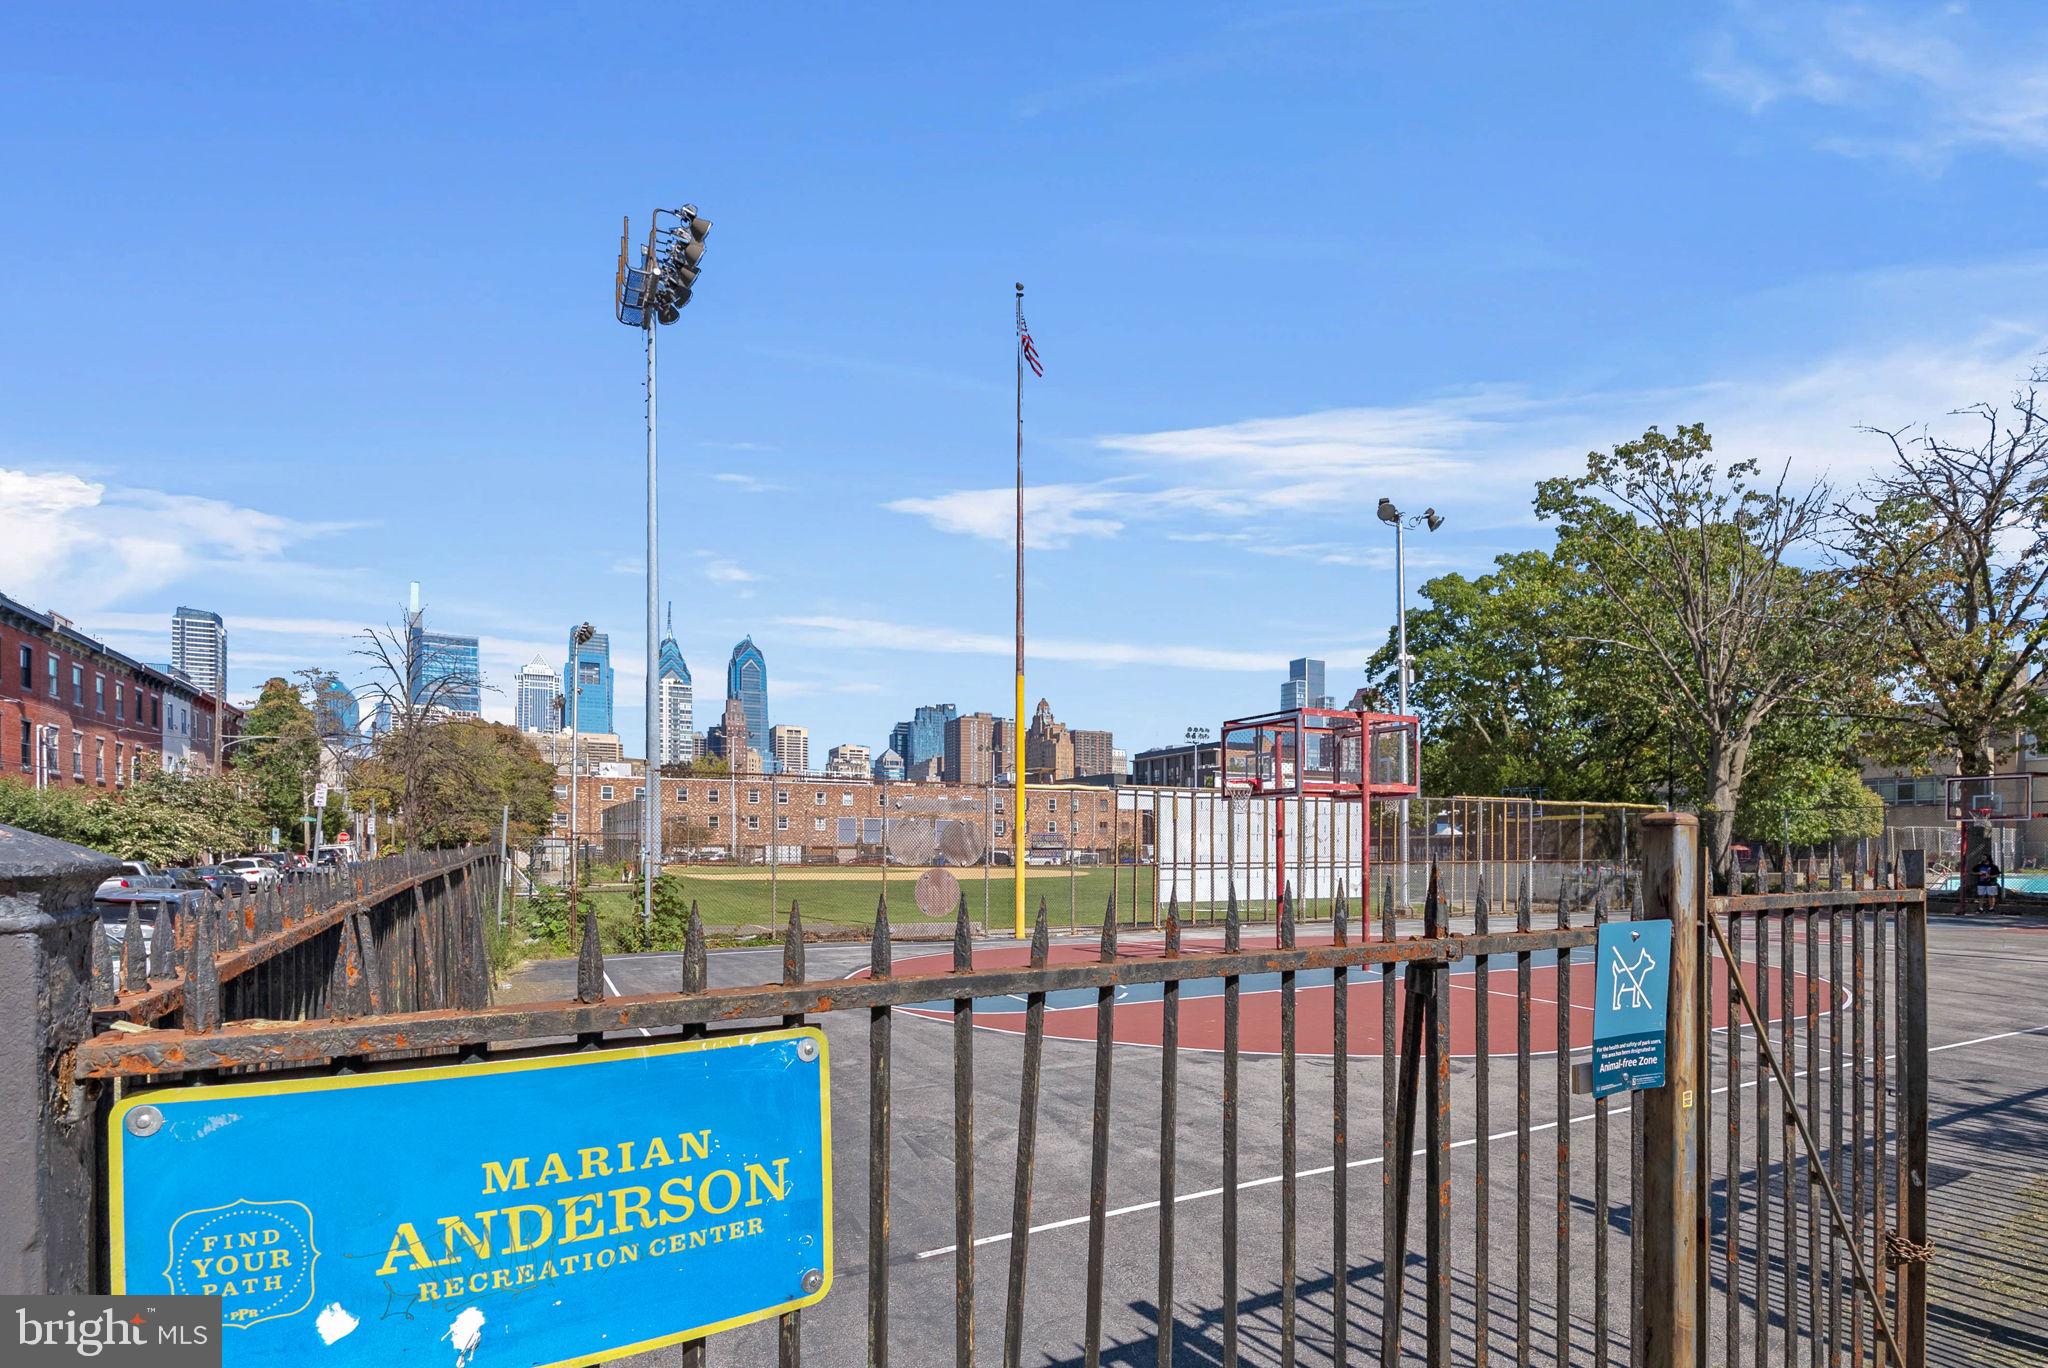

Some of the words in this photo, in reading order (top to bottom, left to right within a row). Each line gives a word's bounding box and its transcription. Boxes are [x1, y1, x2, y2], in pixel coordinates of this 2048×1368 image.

[1599, 1058, 1637, 1073] Animal-free
[1638, 1056, 1658, 1066] Zone
[481, 1129, 712, 1195] MARIAN
[375, 1157, 790, 1276] ANDERSON
[202, 1229, 280, 1253] FIND
[192, 1249, 292, 1279] YOUR
[418, 1243, 641, 1303] RECREATION
[649, 1217, 764, 1257] CENTER
[202, 1275, 282, 1297] PATH
[230, 1308, 259, 1321] PPR
